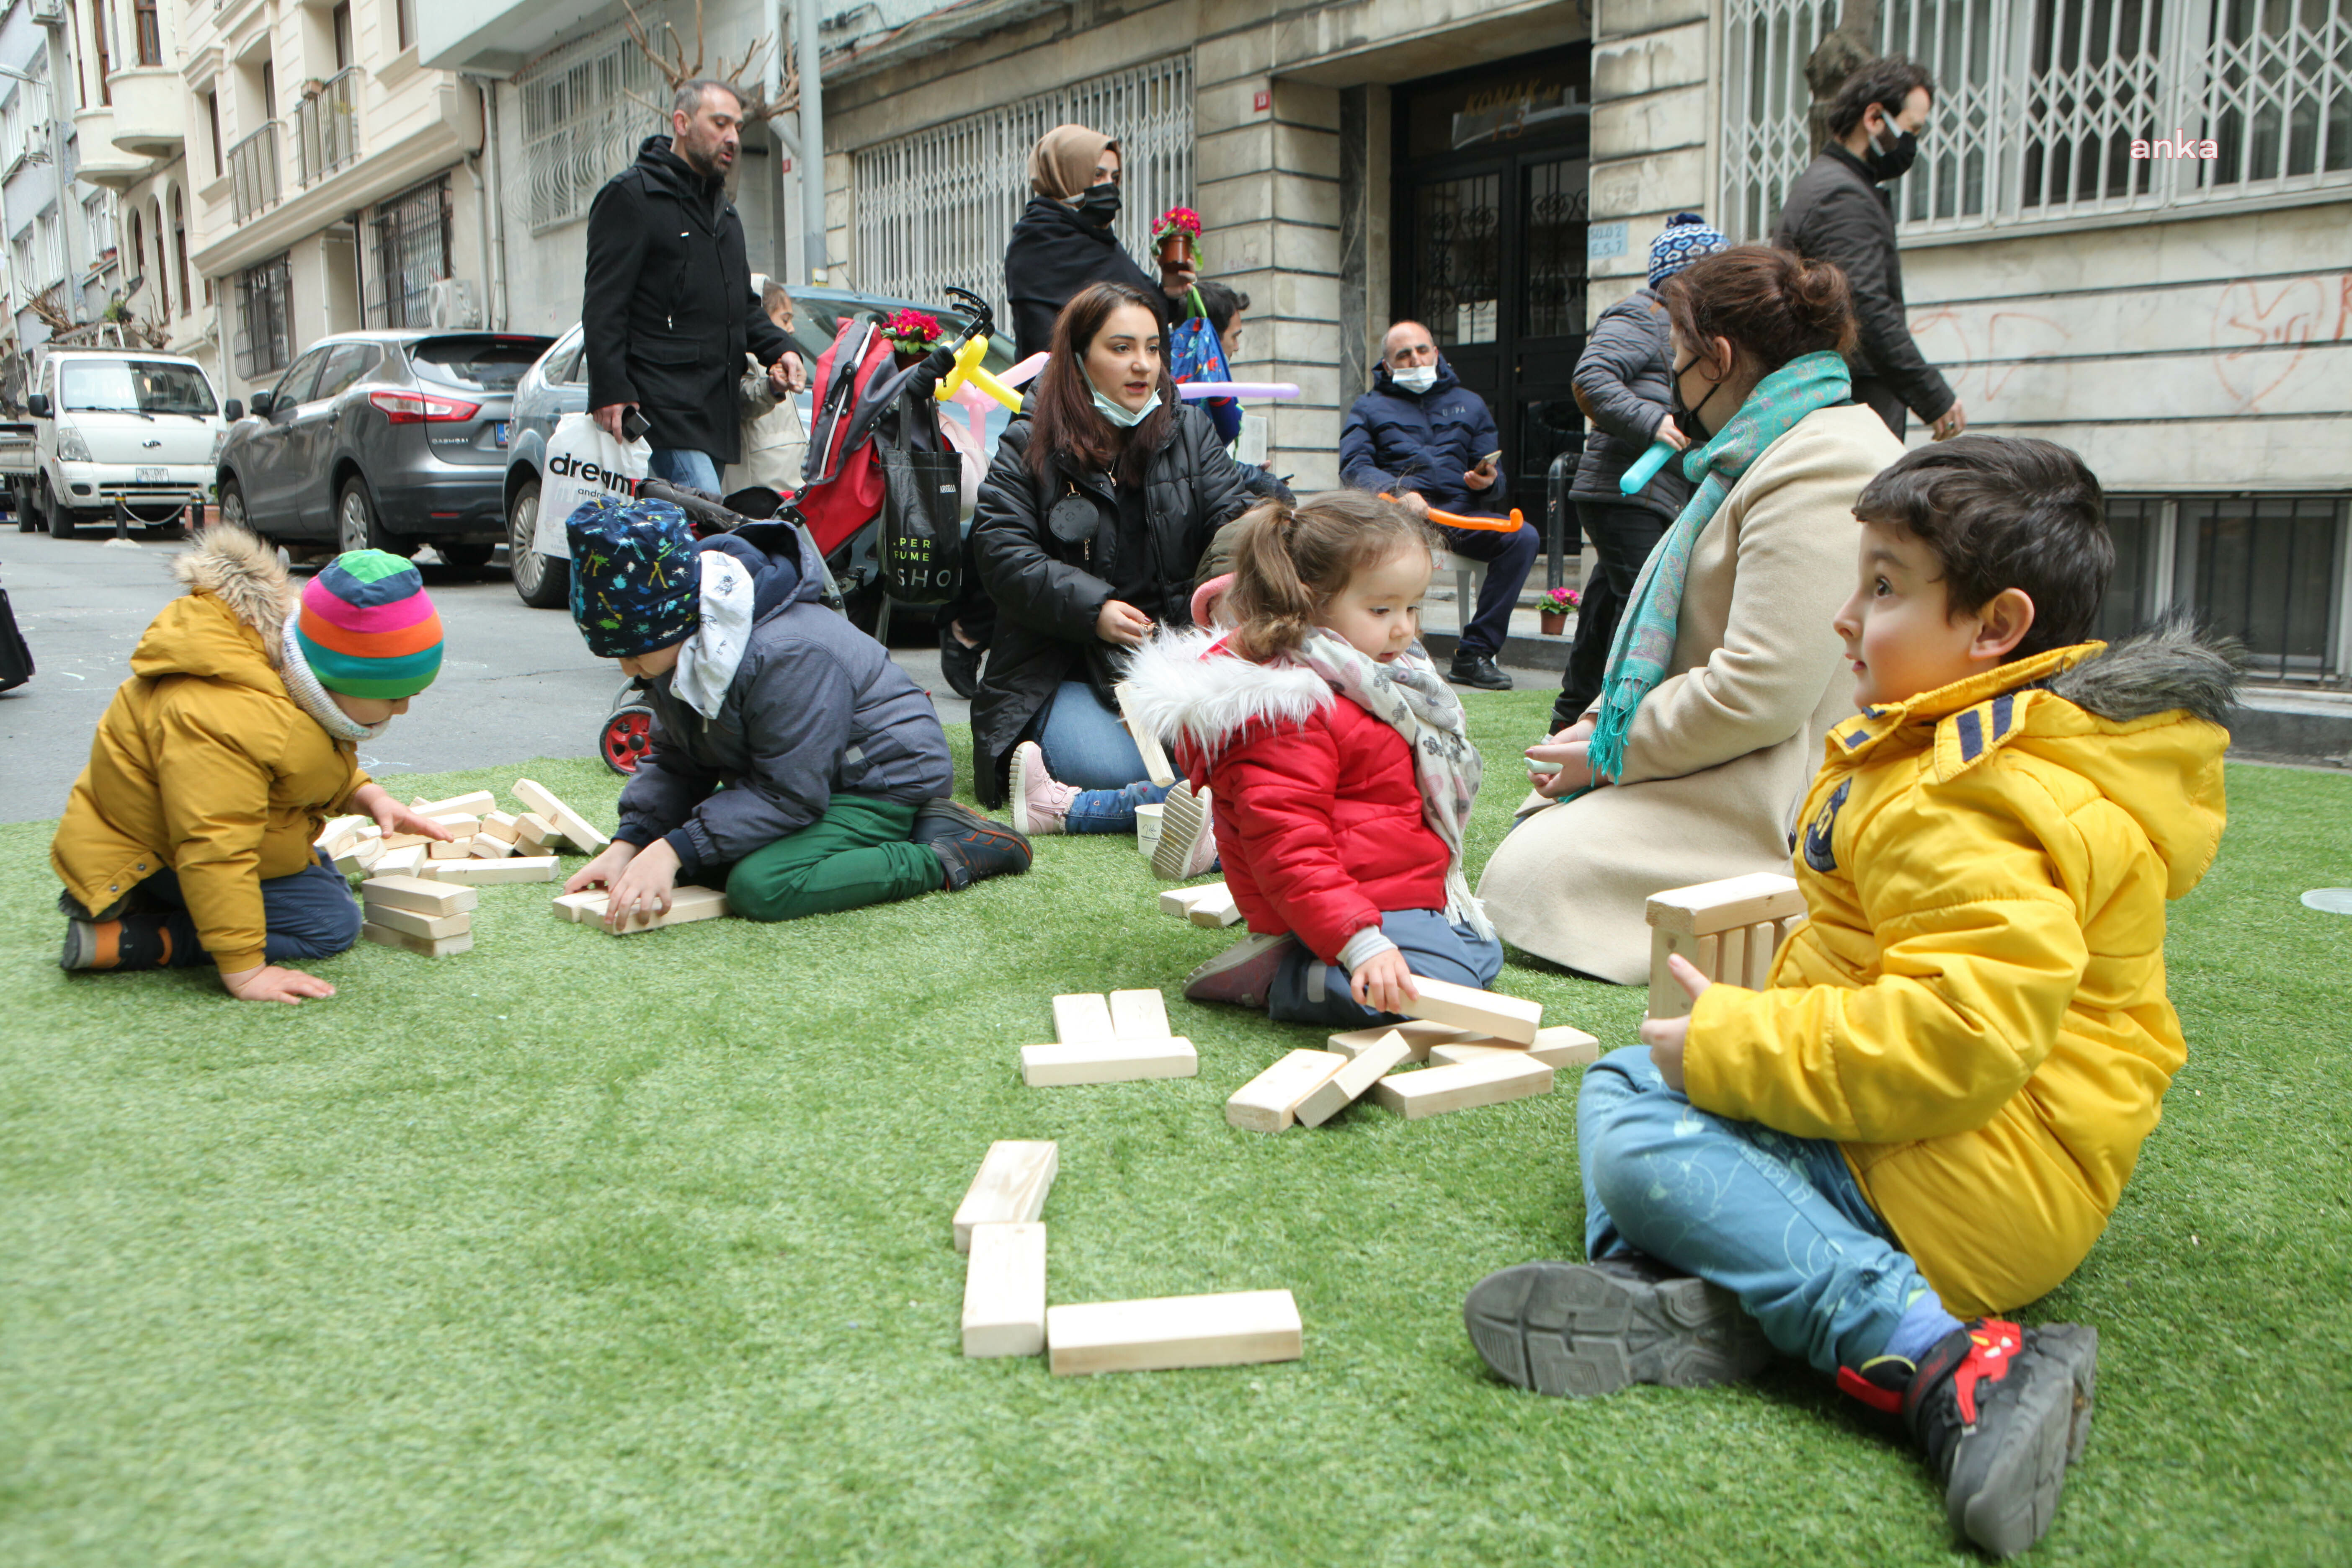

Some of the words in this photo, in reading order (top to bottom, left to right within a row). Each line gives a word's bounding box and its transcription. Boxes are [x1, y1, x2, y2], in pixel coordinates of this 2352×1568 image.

[549, 452, 632, 497] dream
[894, 550, 929, 562] FUME
[897, 568, 962, 588] SHO
